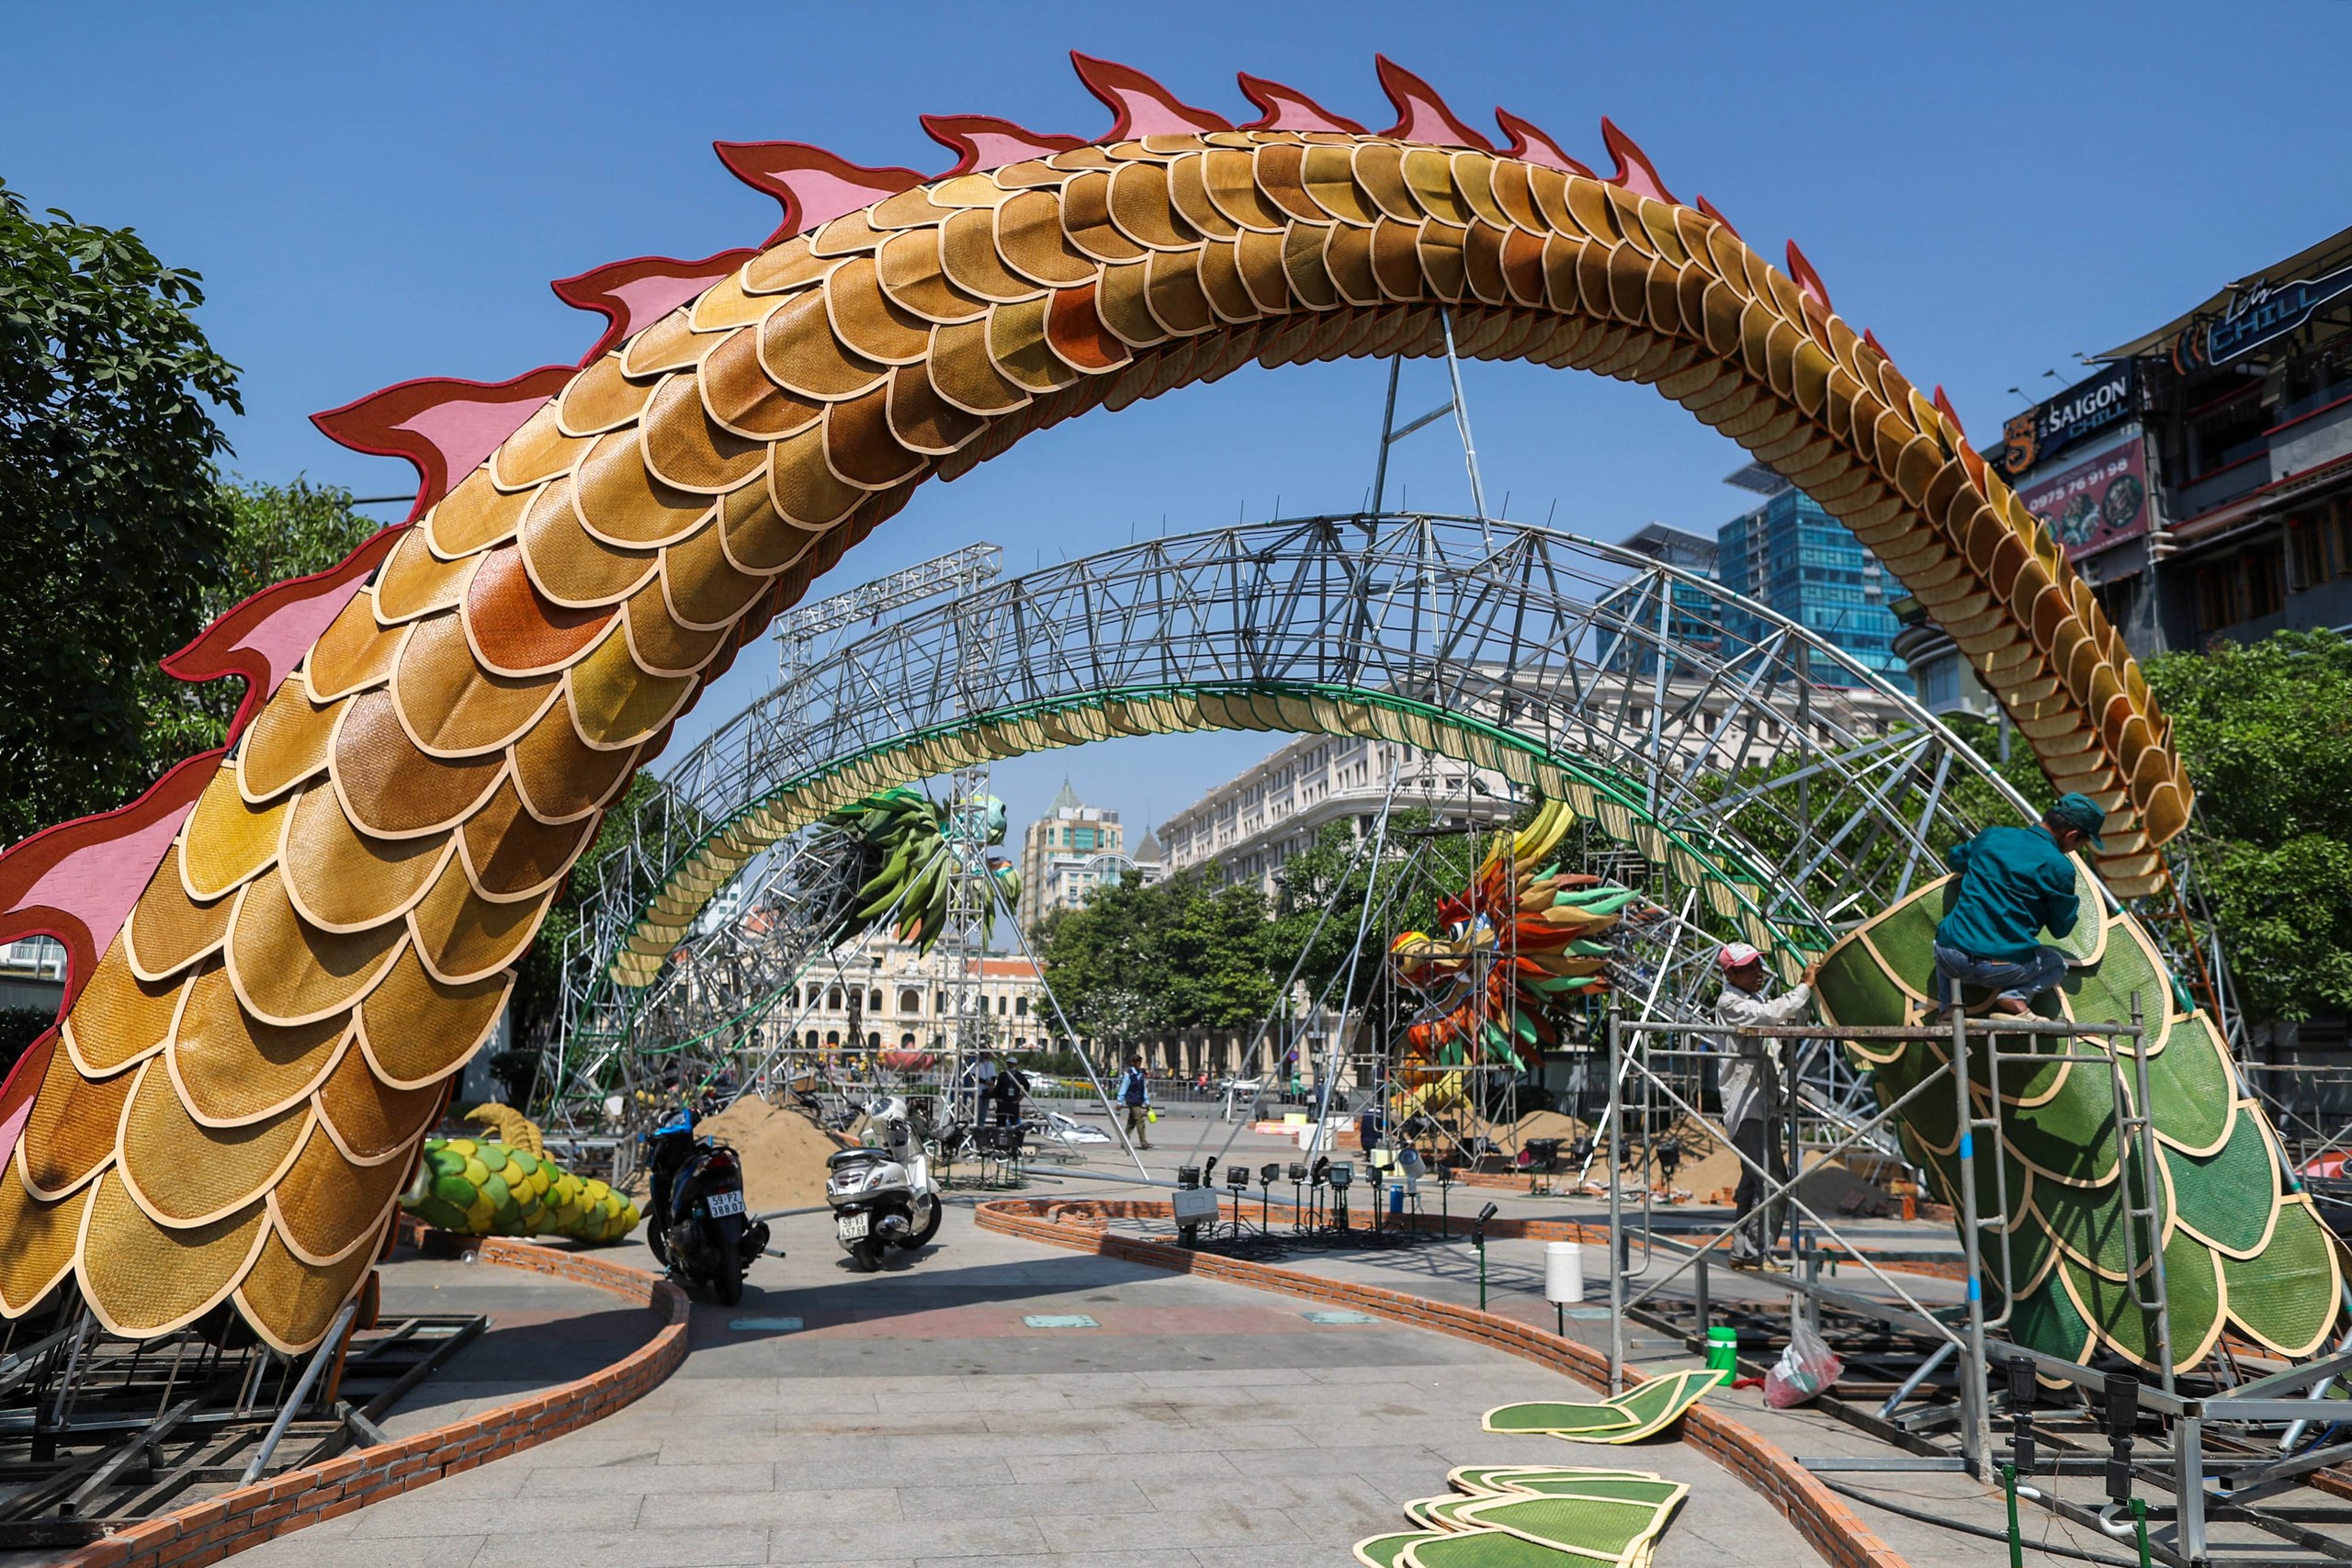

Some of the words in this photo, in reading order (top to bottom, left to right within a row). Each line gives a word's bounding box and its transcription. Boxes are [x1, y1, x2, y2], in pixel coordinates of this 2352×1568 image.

[2211, 288, 2319, 352] CHILL
[2049, 377, 2126, 433] SAIGON
[2068, 402, 2128, 438] CHILL
[2029, 487, 2065, 512] 0975
[2067, 478, 2086, 495] 76
[2088, 468, 2105, 485] 91
[2108, 457, 2128, 477] 98
